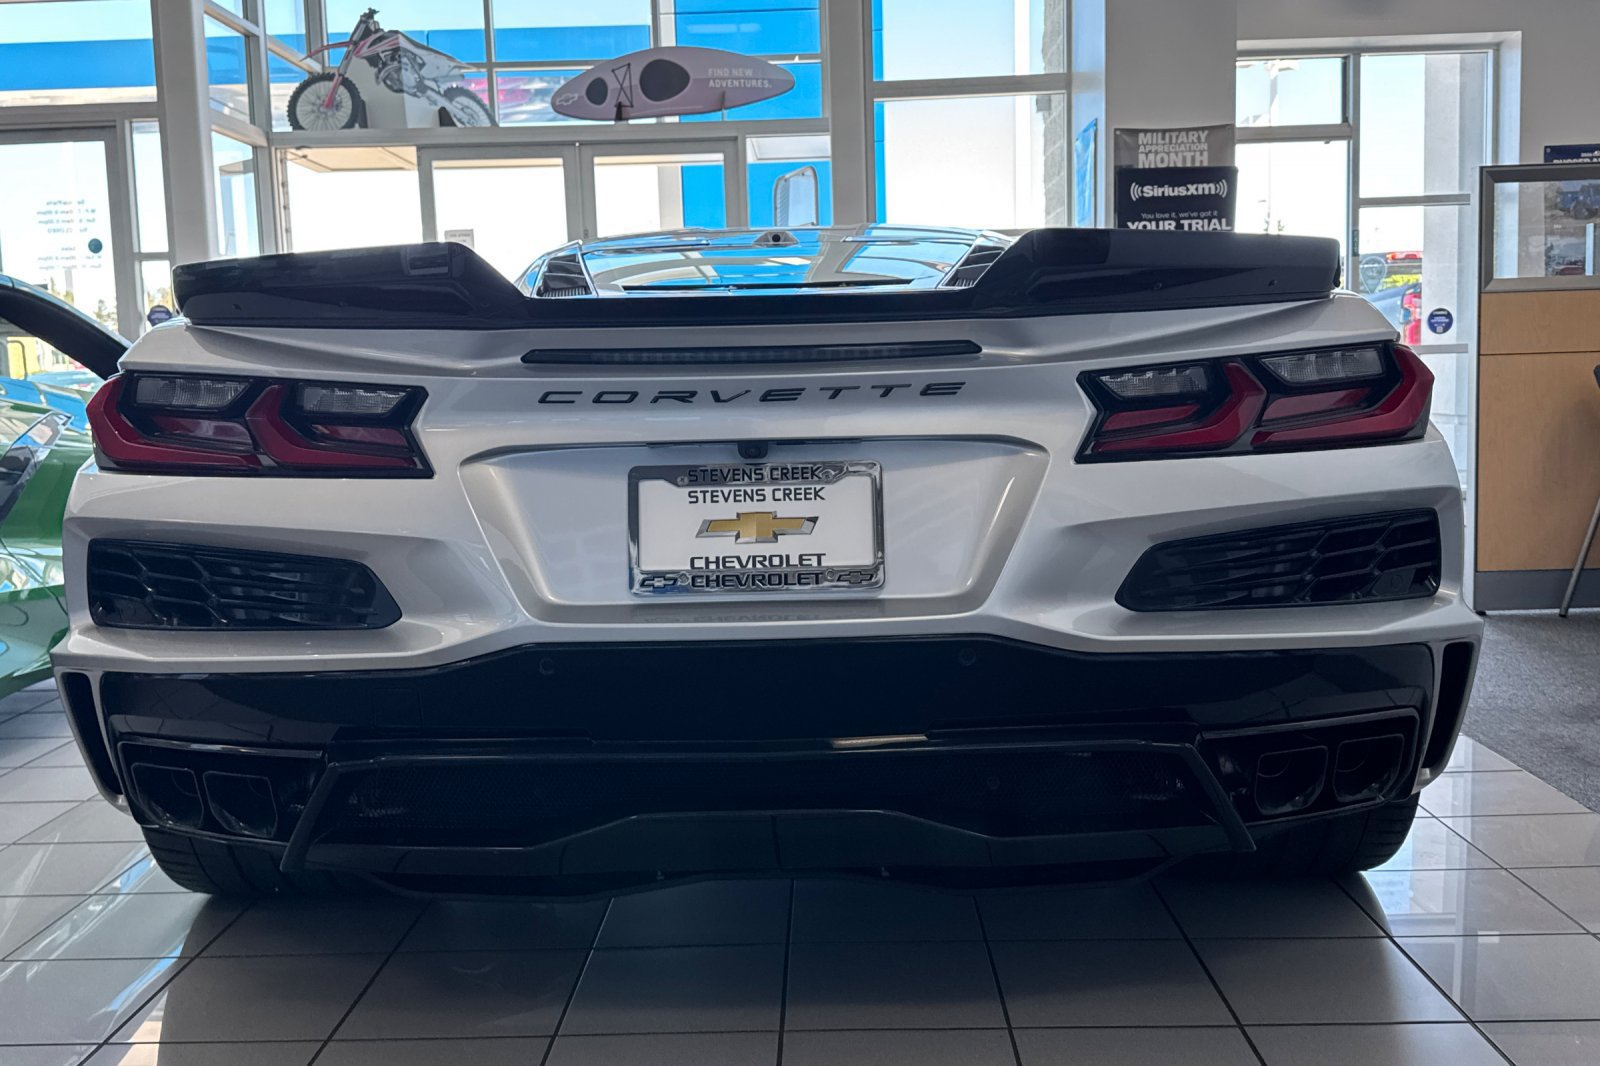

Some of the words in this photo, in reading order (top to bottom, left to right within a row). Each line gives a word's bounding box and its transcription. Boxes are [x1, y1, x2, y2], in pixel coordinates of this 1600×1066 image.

[708, 68, 729, 77] FIND
[732, 68, 753, 77] NEW
[709, 79, 772, 88] ADVENTURES.
[1138, 131, 1208, 145] MILITARY
[1139, 143, 1208, 153] APPRECIATION
[1138, 151, 1208, 168] MONTH
[1127, 220, 1176, 230] YOUR
[1180, 218, 1232, 231] TRIAL
[538, 381, 966, 404] CORVETTE
[688, 469, 764, 482] STEVENS
[770, 466, 823, 480] CREEK
[688, 489, 766, 504] STEVENS
[772, 487, 825, 501] CREEK
[690, 553, 826, 570] CHEVROLET
[691, 572, 823, 588] CHEVROLET
